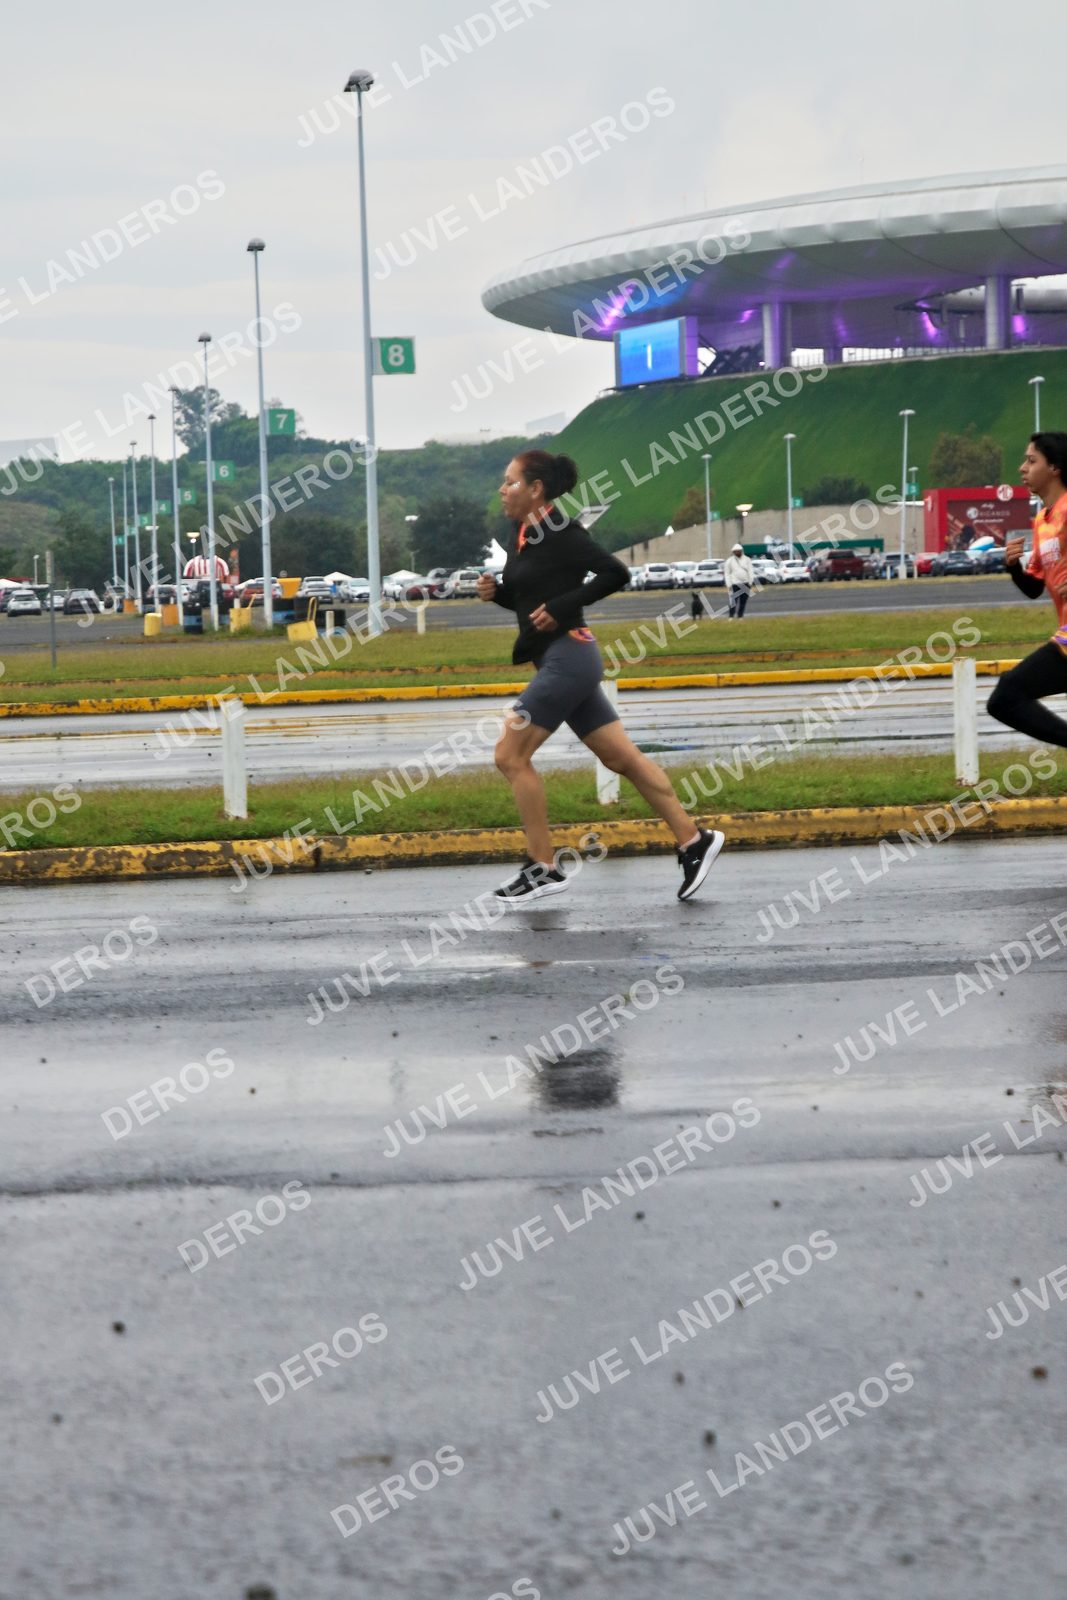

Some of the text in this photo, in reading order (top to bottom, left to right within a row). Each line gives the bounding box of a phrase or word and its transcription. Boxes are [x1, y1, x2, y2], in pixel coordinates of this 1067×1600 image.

[388, 344, 404, 366] 8
[275, 413, 288, 430] 7
[219, 465, 229, 478] 6
[184, 490, 192, 501] 5
[159, 503, 166, 512] 4
